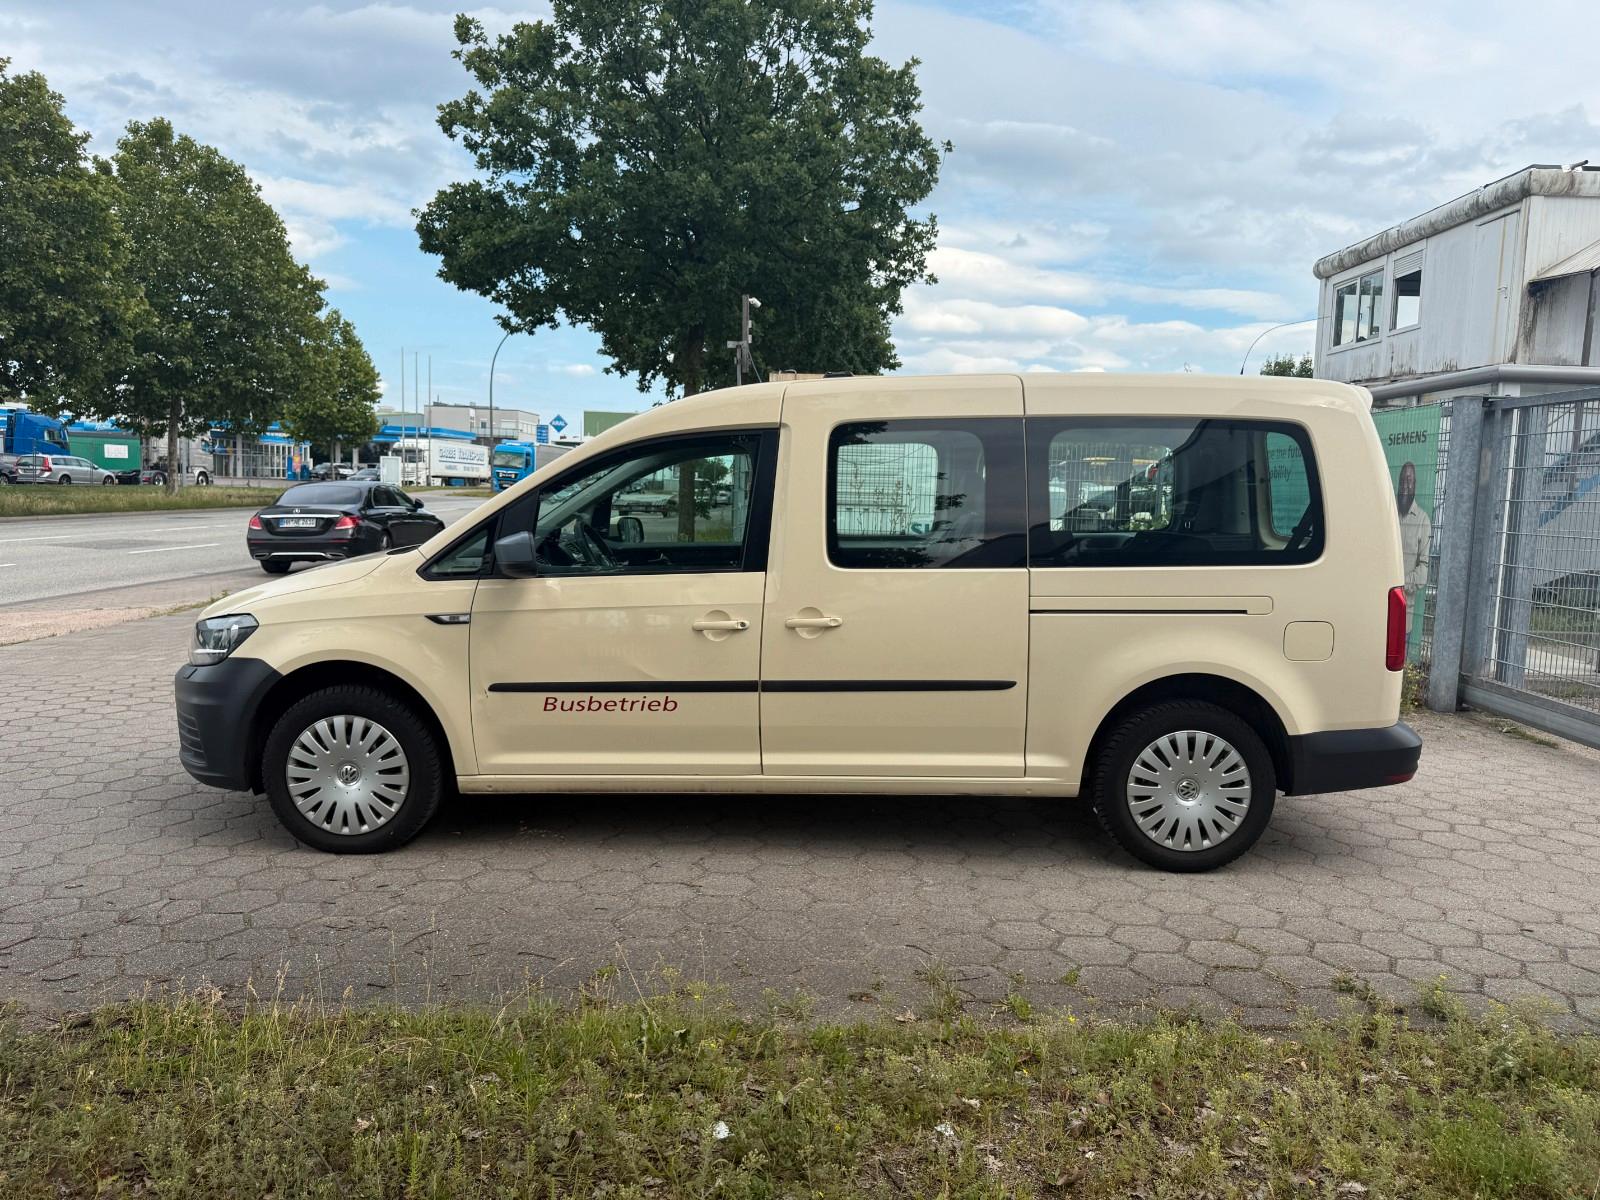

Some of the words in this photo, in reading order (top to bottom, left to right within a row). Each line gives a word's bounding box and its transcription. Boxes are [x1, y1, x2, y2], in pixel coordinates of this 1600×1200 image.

[1387, 430, 1428, 446] SIEMENS
[458, 449, 485, 462] TRANSPORT
[1269, 463, 1291, 482] obility
[543, 696, 678, 712] Busbetrieb
